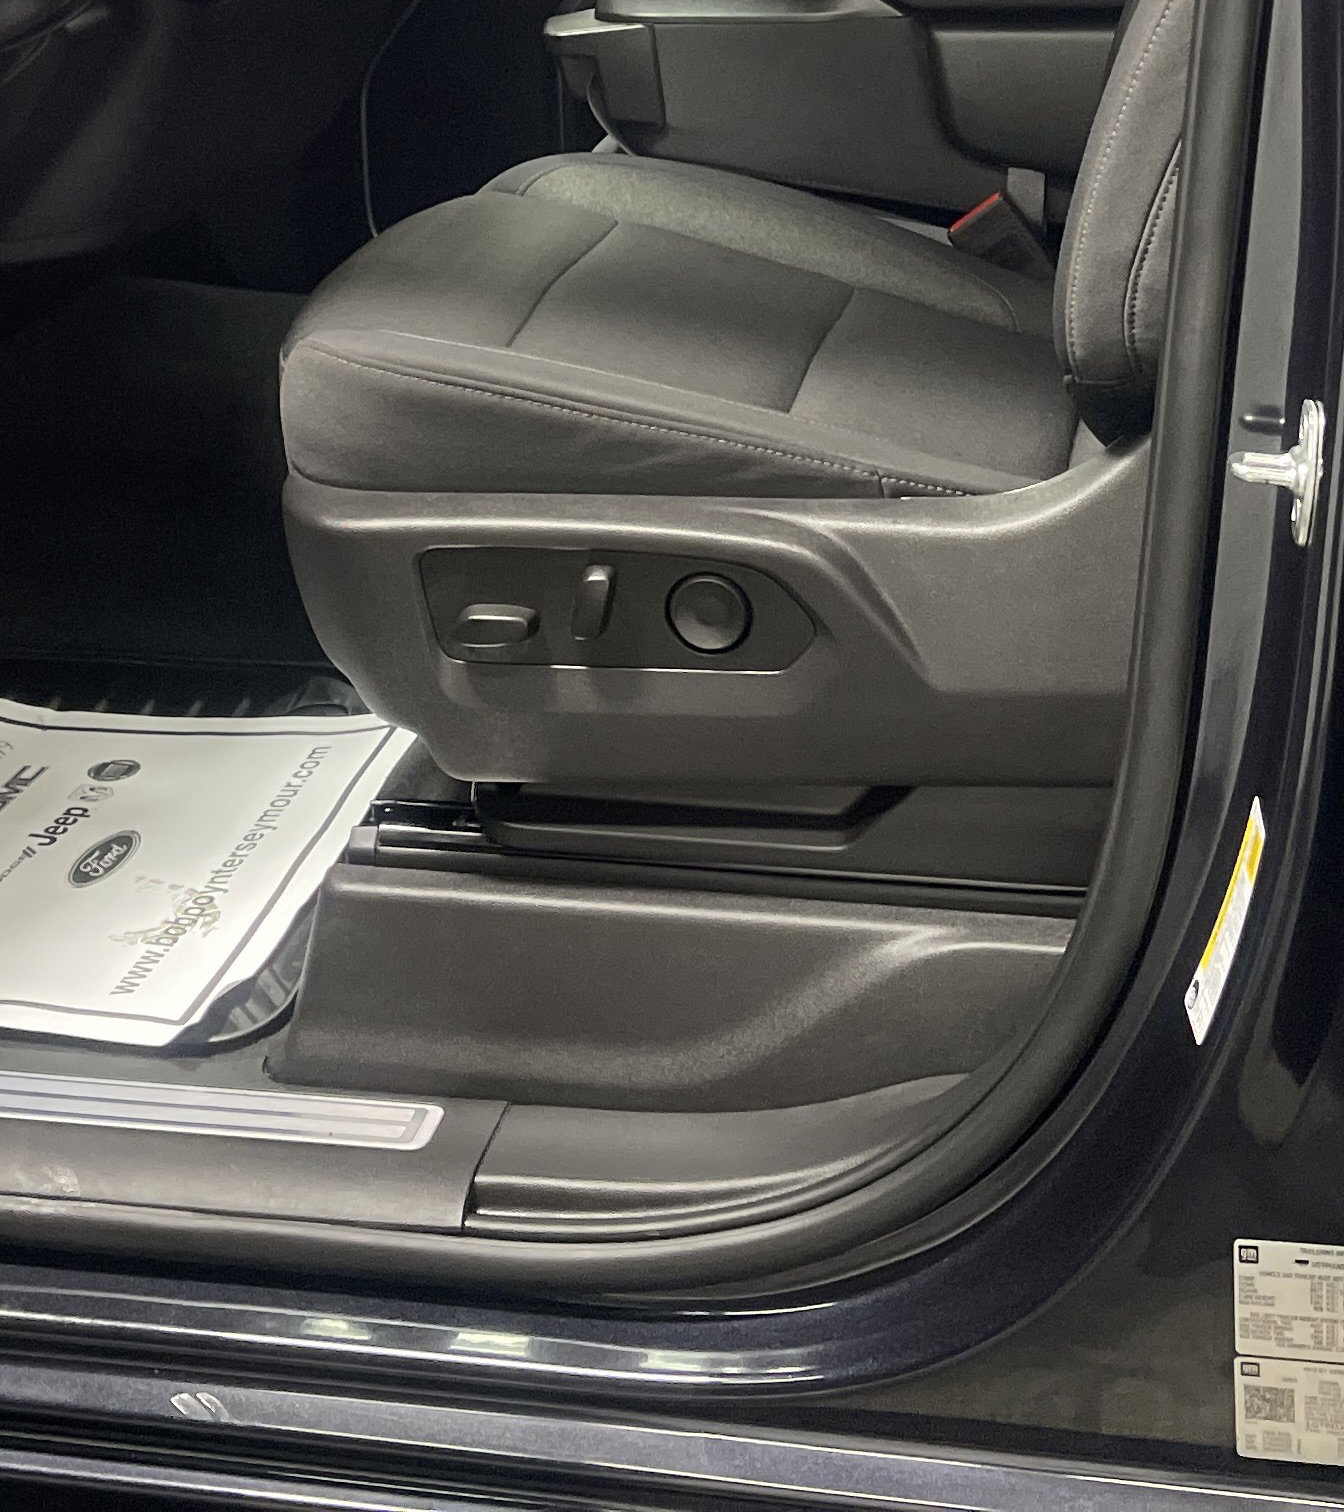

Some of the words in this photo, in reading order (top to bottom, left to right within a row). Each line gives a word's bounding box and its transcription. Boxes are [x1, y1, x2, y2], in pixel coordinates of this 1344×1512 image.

[28, 806, 91, 847] Jeep
[80, 842, 128, 877] Ford
[109, 744, 333, 996] www.bobpoynterseymour.com
